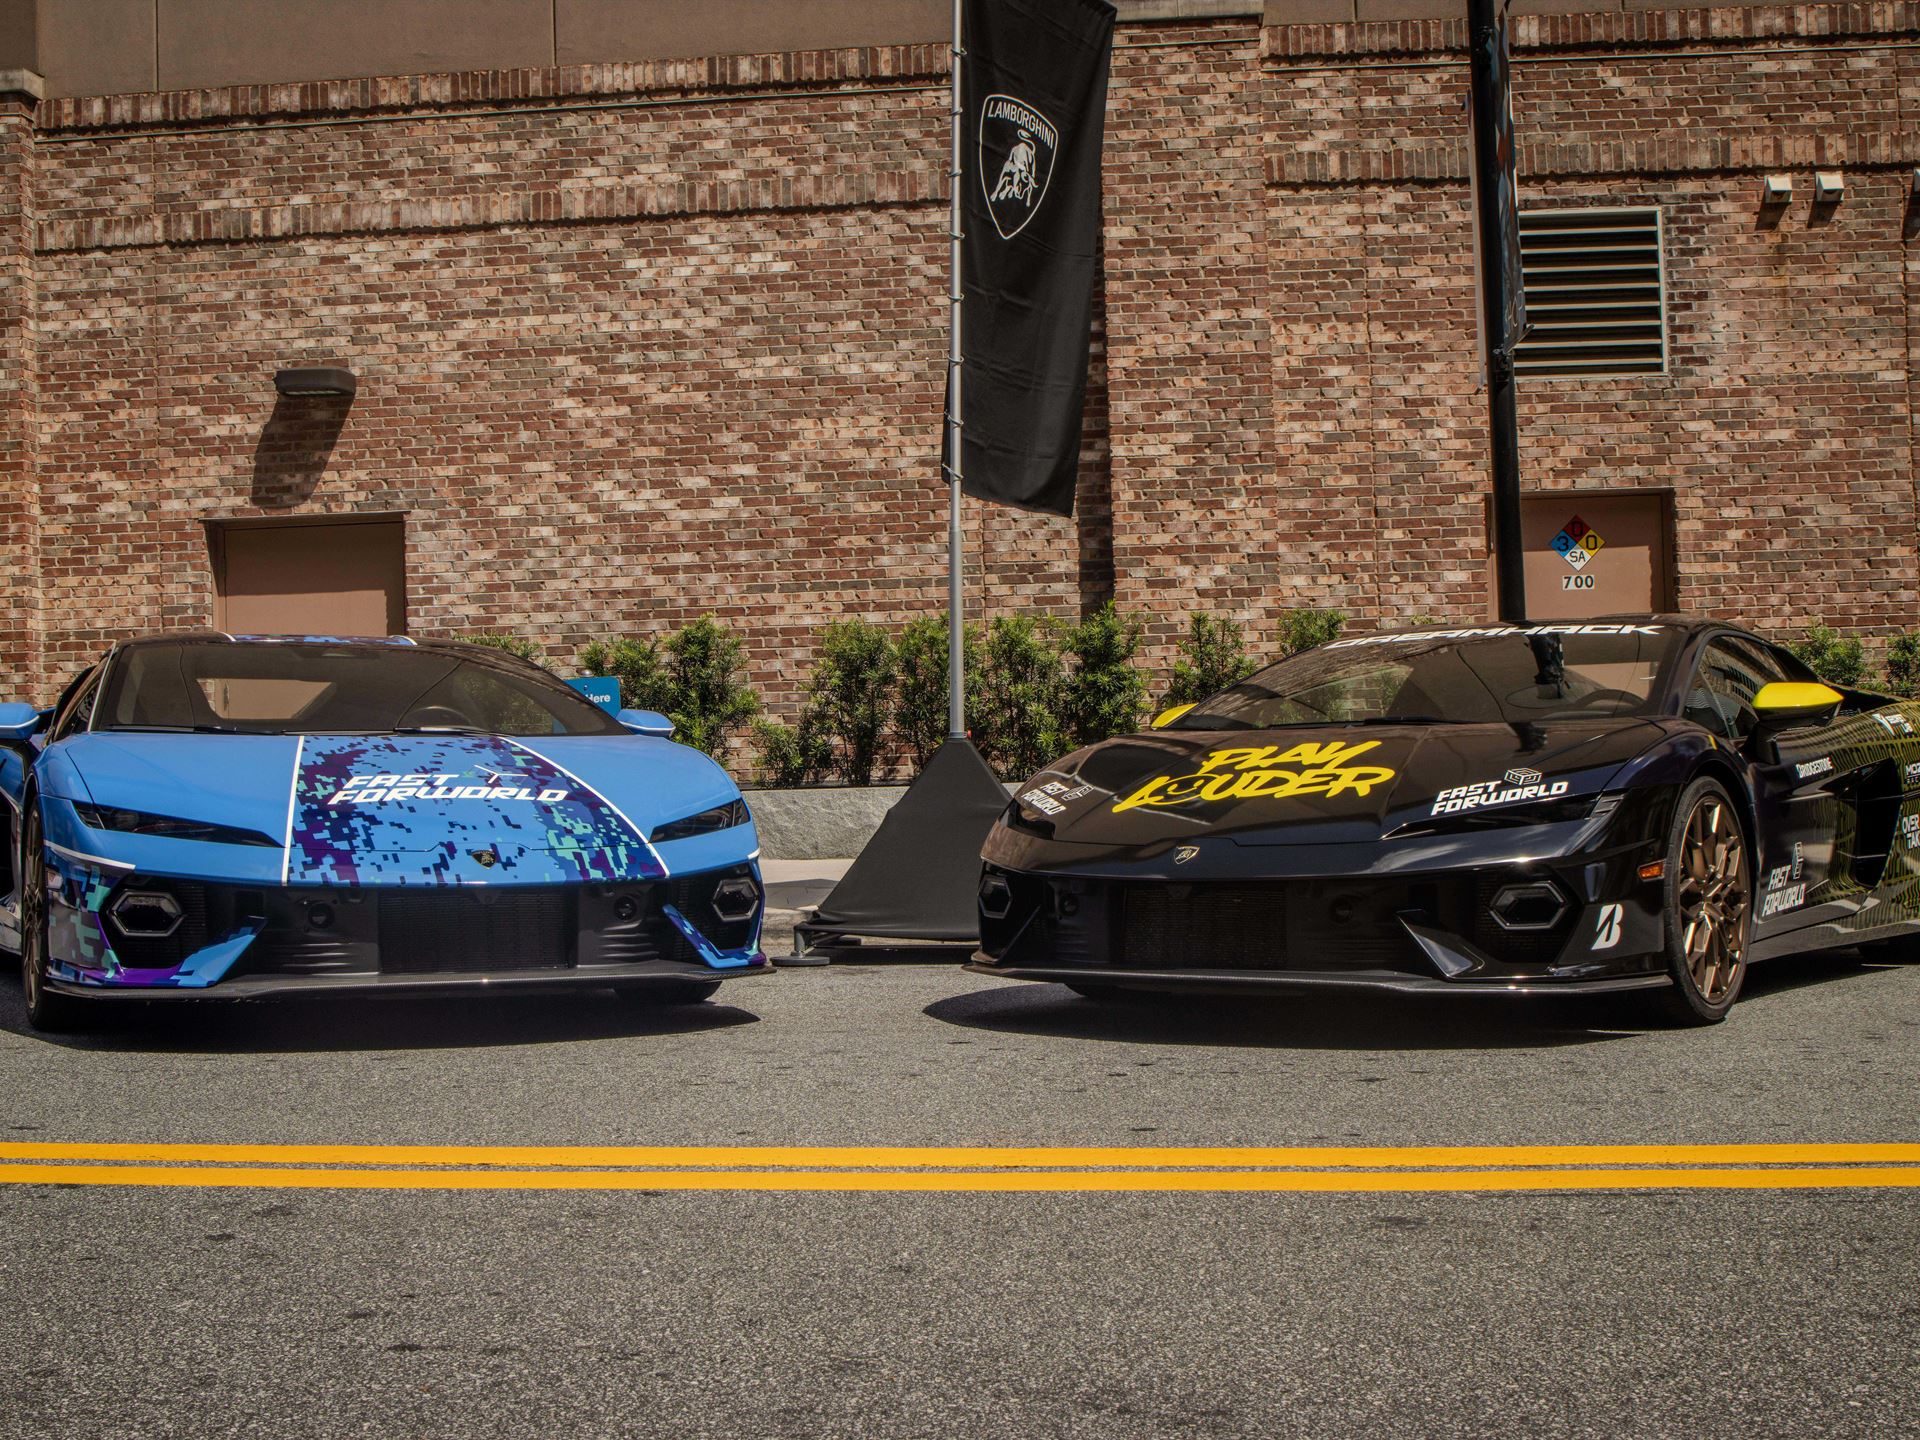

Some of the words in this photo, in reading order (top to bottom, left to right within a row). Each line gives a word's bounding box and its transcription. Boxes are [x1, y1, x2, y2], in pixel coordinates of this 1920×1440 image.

[987, 100, 1054, 149] LAMBORGHINI
[1556, 536, 1569, 552] 3
[1586, 535, 1598, 550] 0
[1569, 551, 1586, 563] SA
[1563, 575, 1594, 589] 700
[1322, 624, 1665, 650] DREAMHACK
[1198, 740, 1383, 775] PLAY
[343, 774, 460, 789] FAST
[1112, 766, 1395, 813] LOUDER
[1436, 781, 1502, 802] FAST
[327, 786, 569, 805] FORWORLD
[1430, 781, 1569, 816] FORWORLD
[1768, 864, 1792, 891] FAST
